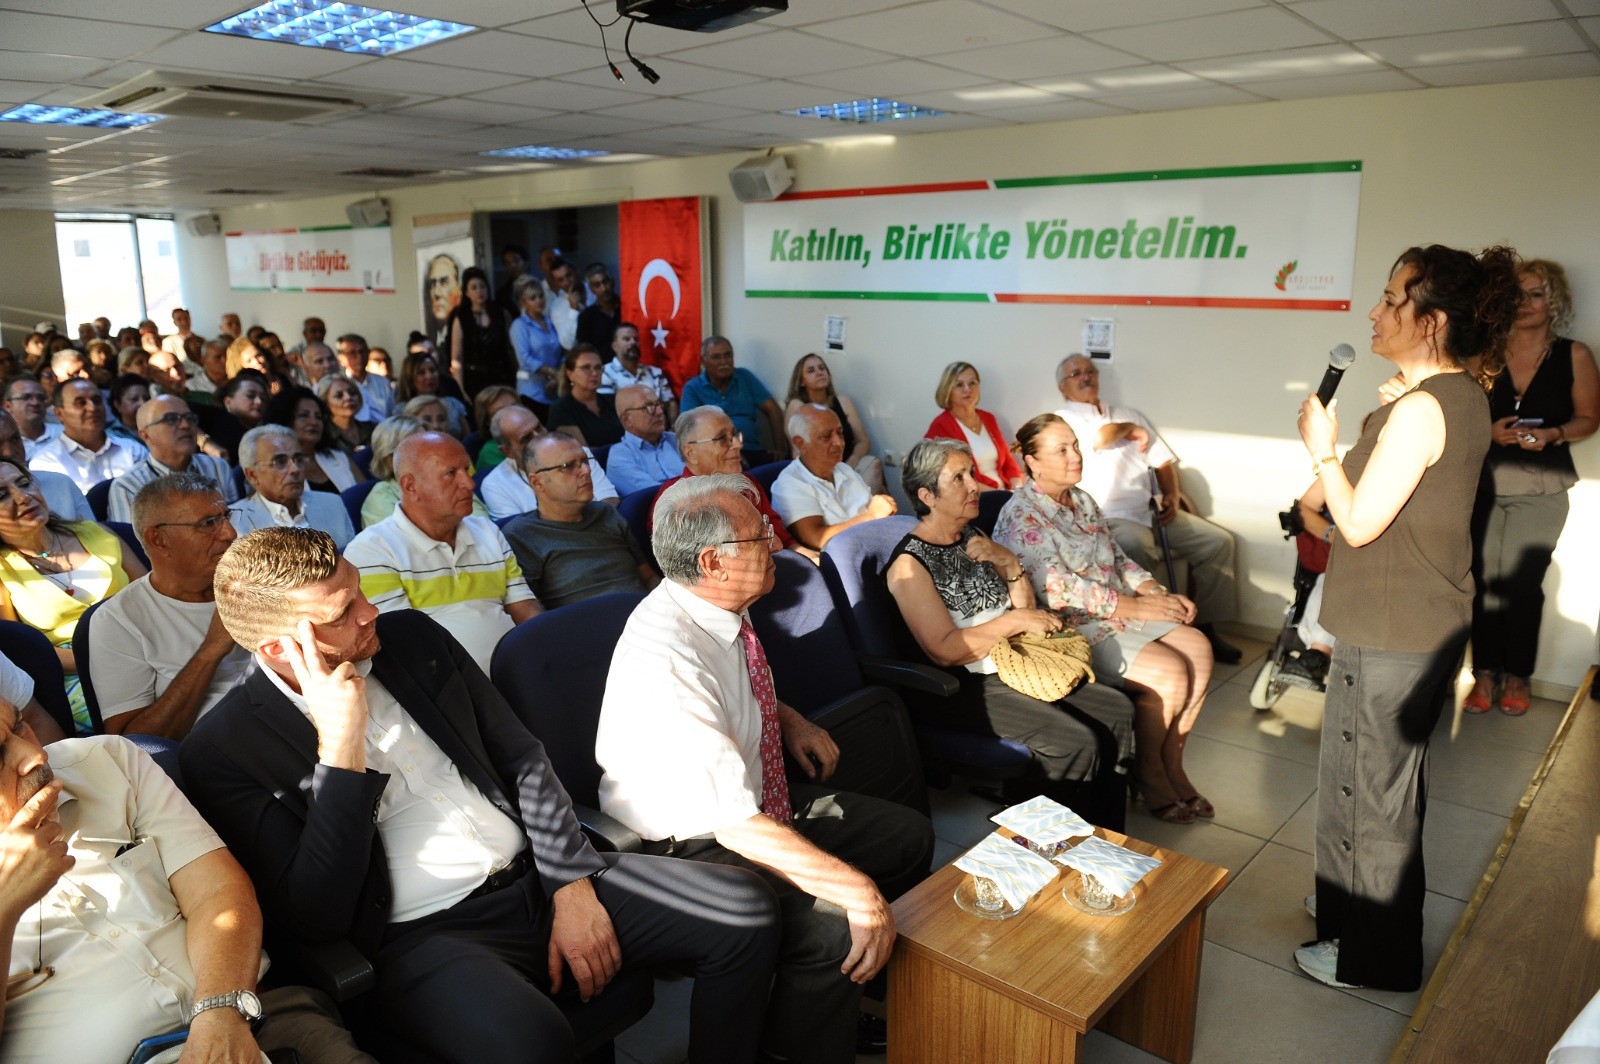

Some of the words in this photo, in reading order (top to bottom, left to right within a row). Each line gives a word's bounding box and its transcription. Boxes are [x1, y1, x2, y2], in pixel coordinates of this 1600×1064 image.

[771, 227, 871, 268] Katılın,
[882, 222, 1009, 260] Birlikte
[1025, 216, 1247, 261] Yönetelim.
[259, 252, 293, 271] Birlikte
